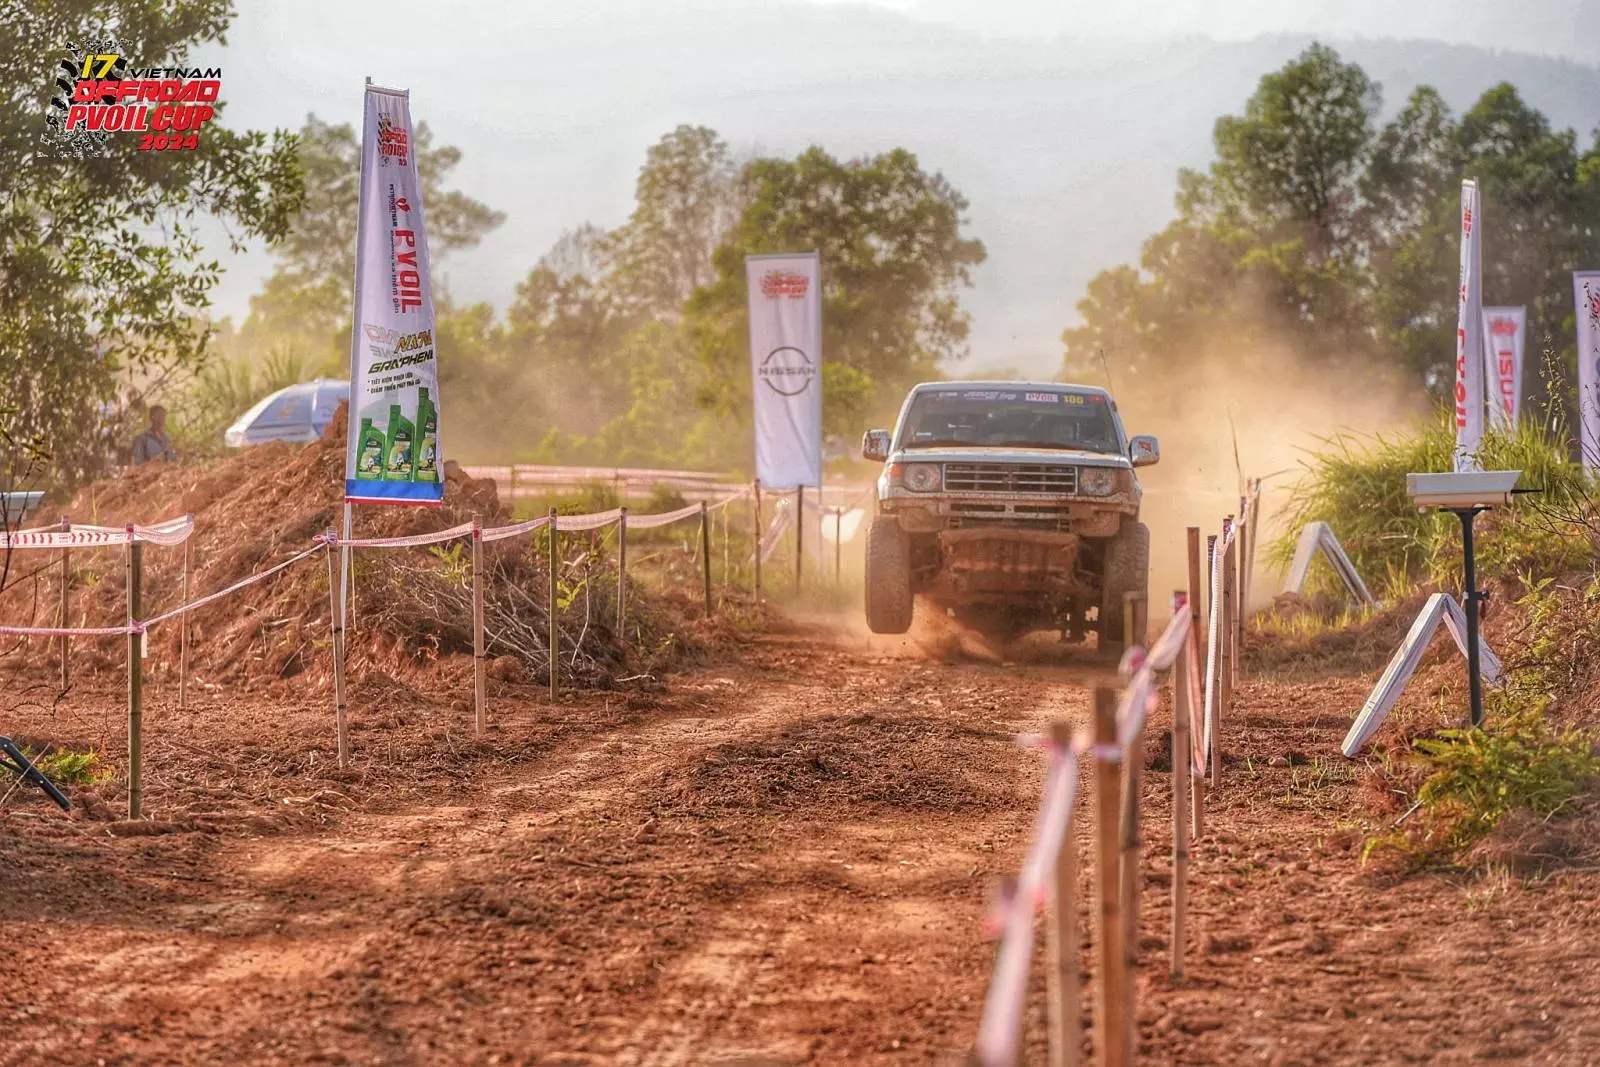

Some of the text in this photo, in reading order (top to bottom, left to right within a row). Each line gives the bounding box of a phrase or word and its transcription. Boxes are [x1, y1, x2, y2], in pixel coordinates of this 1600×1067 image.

[395, 229, 422, 314] PVOIL
[368, 349, 434, 374] GRAPHEN
[393, 329, 433, 354] NAN
[1498, 351, 1514, 416] ISUZ
